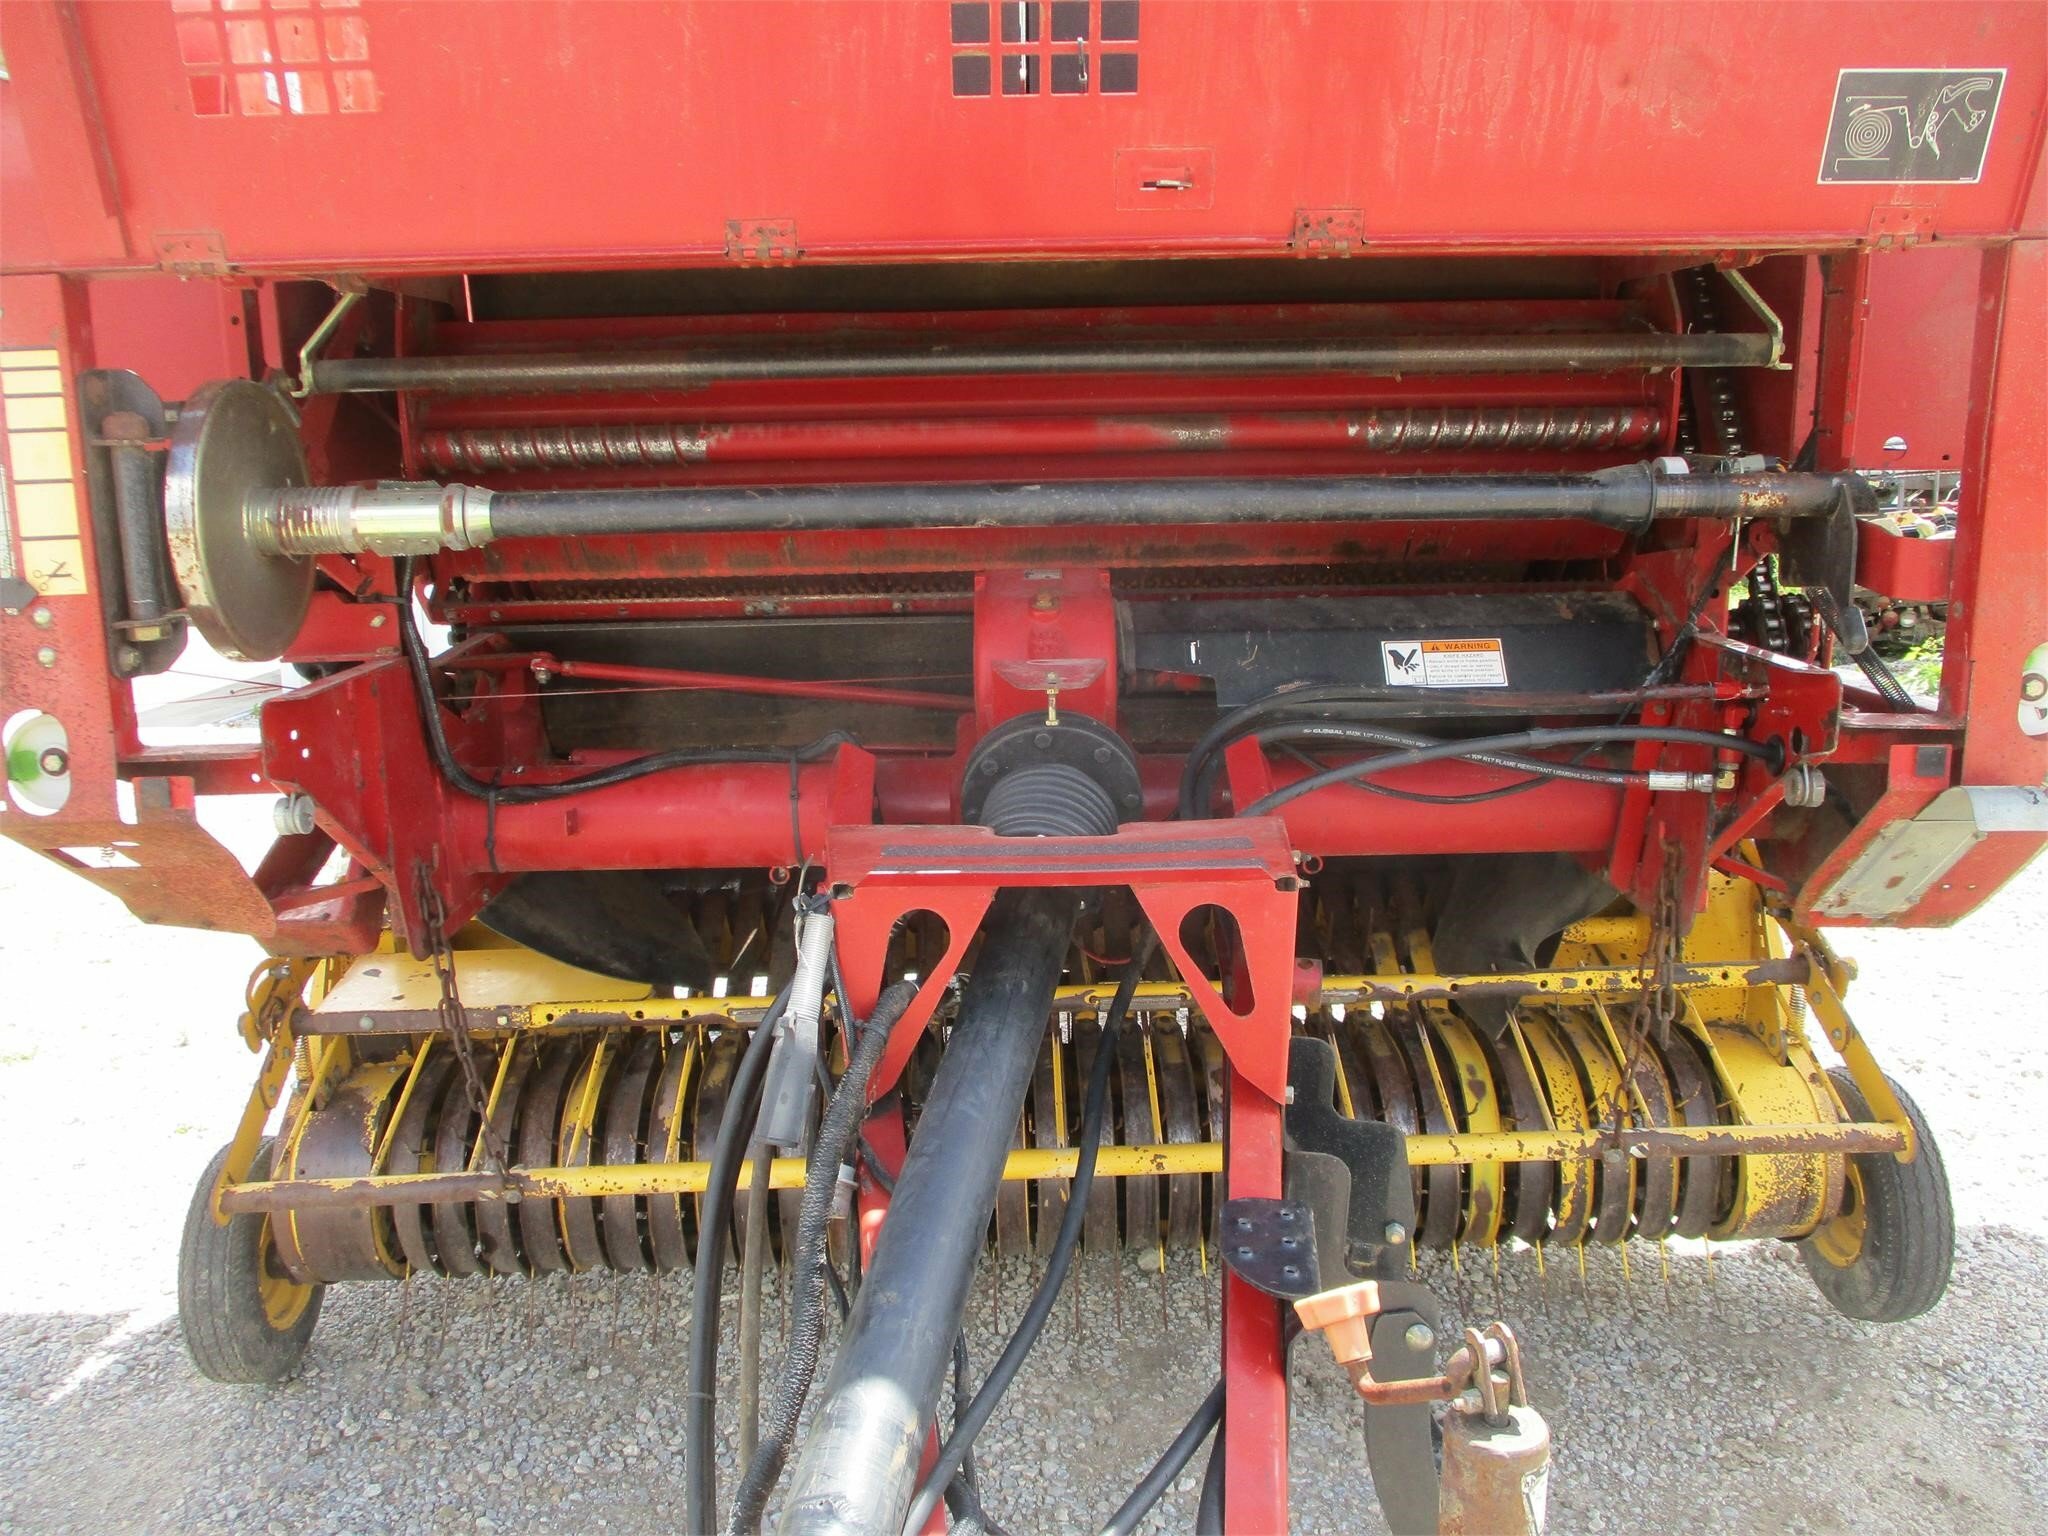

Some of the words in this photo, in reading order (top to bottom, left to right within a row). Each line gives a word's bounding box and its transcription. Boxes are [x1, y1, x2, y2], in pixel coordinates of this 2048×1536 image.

[1444, 642, 1490, 650] WARNING
[1496, 757, 1517, 767] FLAME
[1517, 762, 1553, 774] RESISTANT
